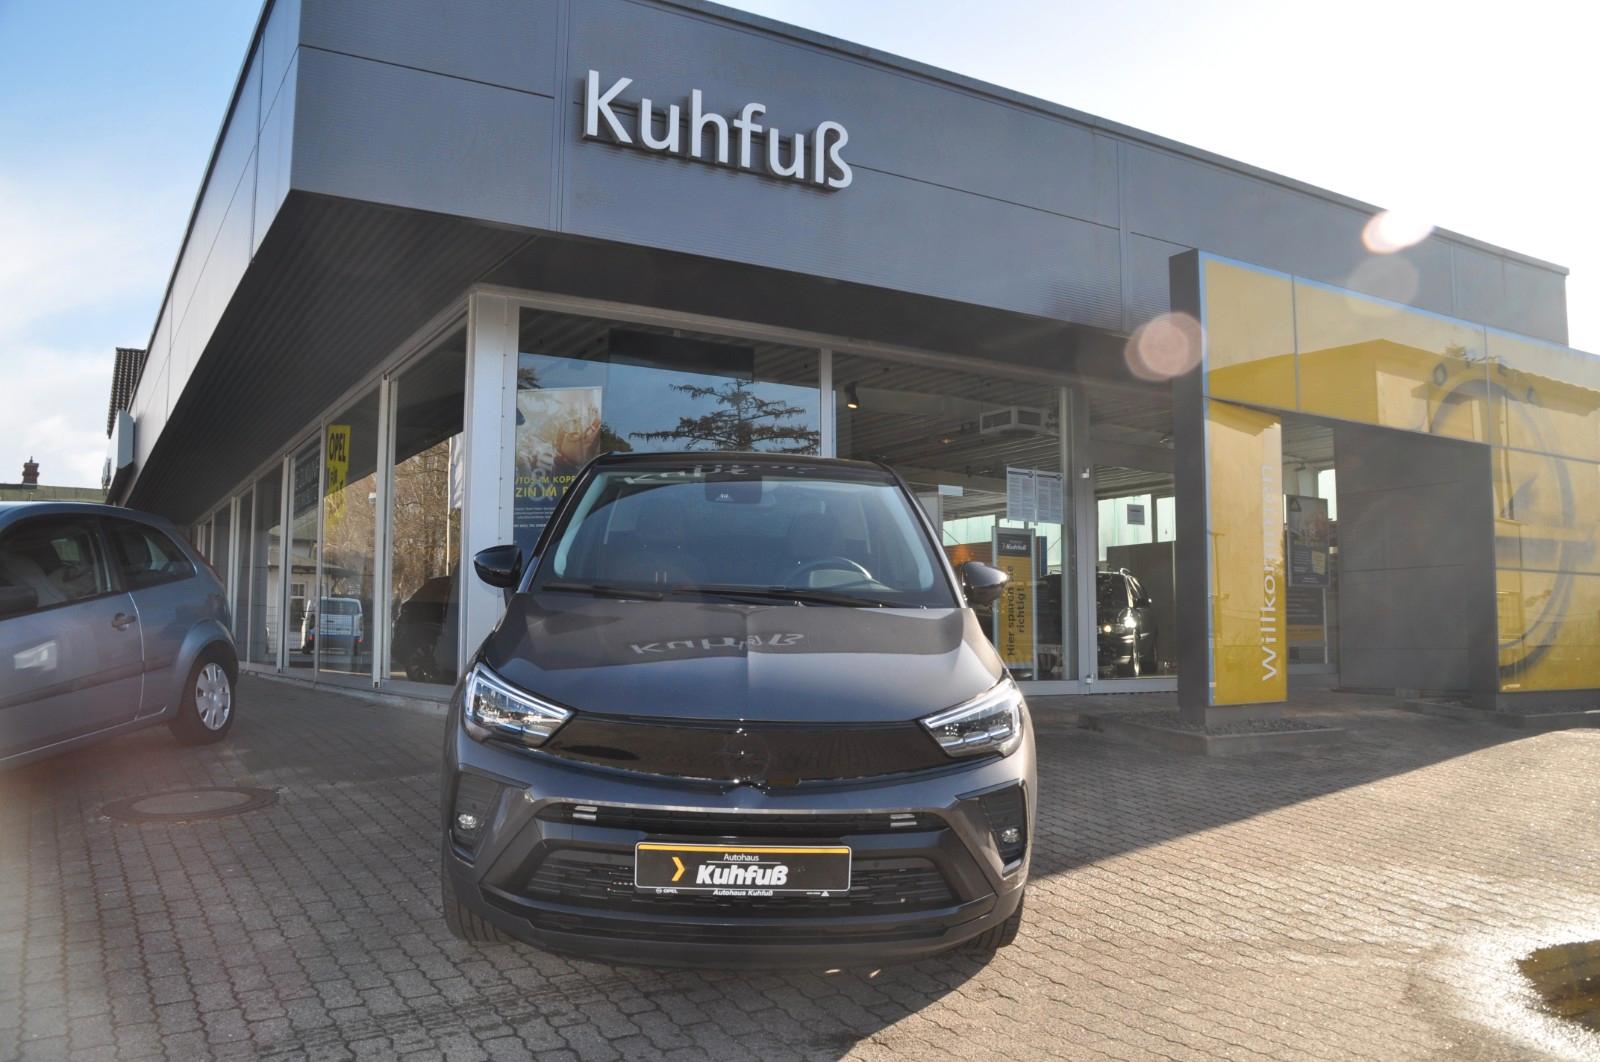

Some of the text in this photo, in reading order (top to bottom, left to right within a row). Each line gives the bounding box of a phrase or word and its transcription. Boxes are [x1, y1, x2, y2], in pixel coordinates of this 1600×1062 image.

[584, 69, 853, 189] Kuhfuß
[329, 432, 346, 462] OPEL
[1006, 632, 1015, 656] Hier
[723, 853, 760, 862] Autohaus
[696, 864, 789, 886] Kuhfuß
[712, 889, 774, 897] Autohaus Kuhfuß
